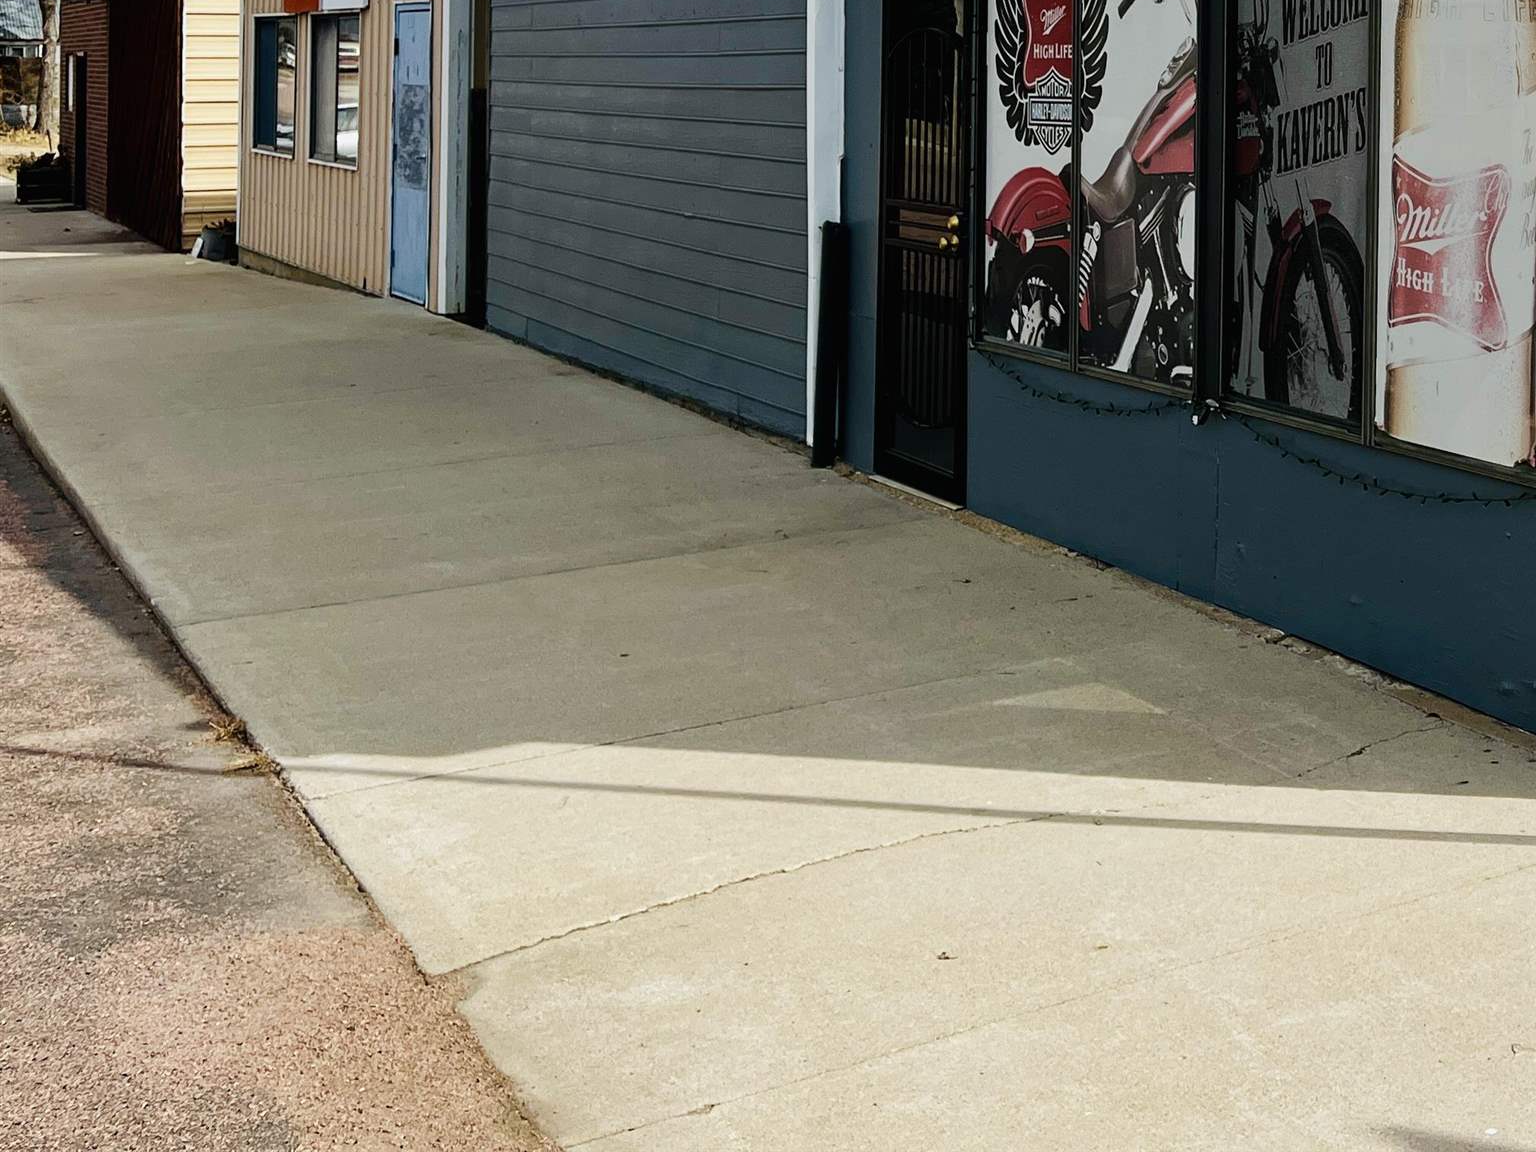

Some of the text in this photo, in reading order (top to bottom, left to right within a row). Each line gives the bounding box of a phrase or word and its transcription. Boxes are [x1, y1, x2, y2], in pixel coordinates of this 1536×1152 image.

[1040, 5, 1067, 34] Miller
[1033, 42, 1072, 60] HIGH LIFE
[1315, 41, 1333, 89] TO
[1041, 78, 1065, 97] MOTOR
[1276, 87, 1367, 175] KAVERN'S
